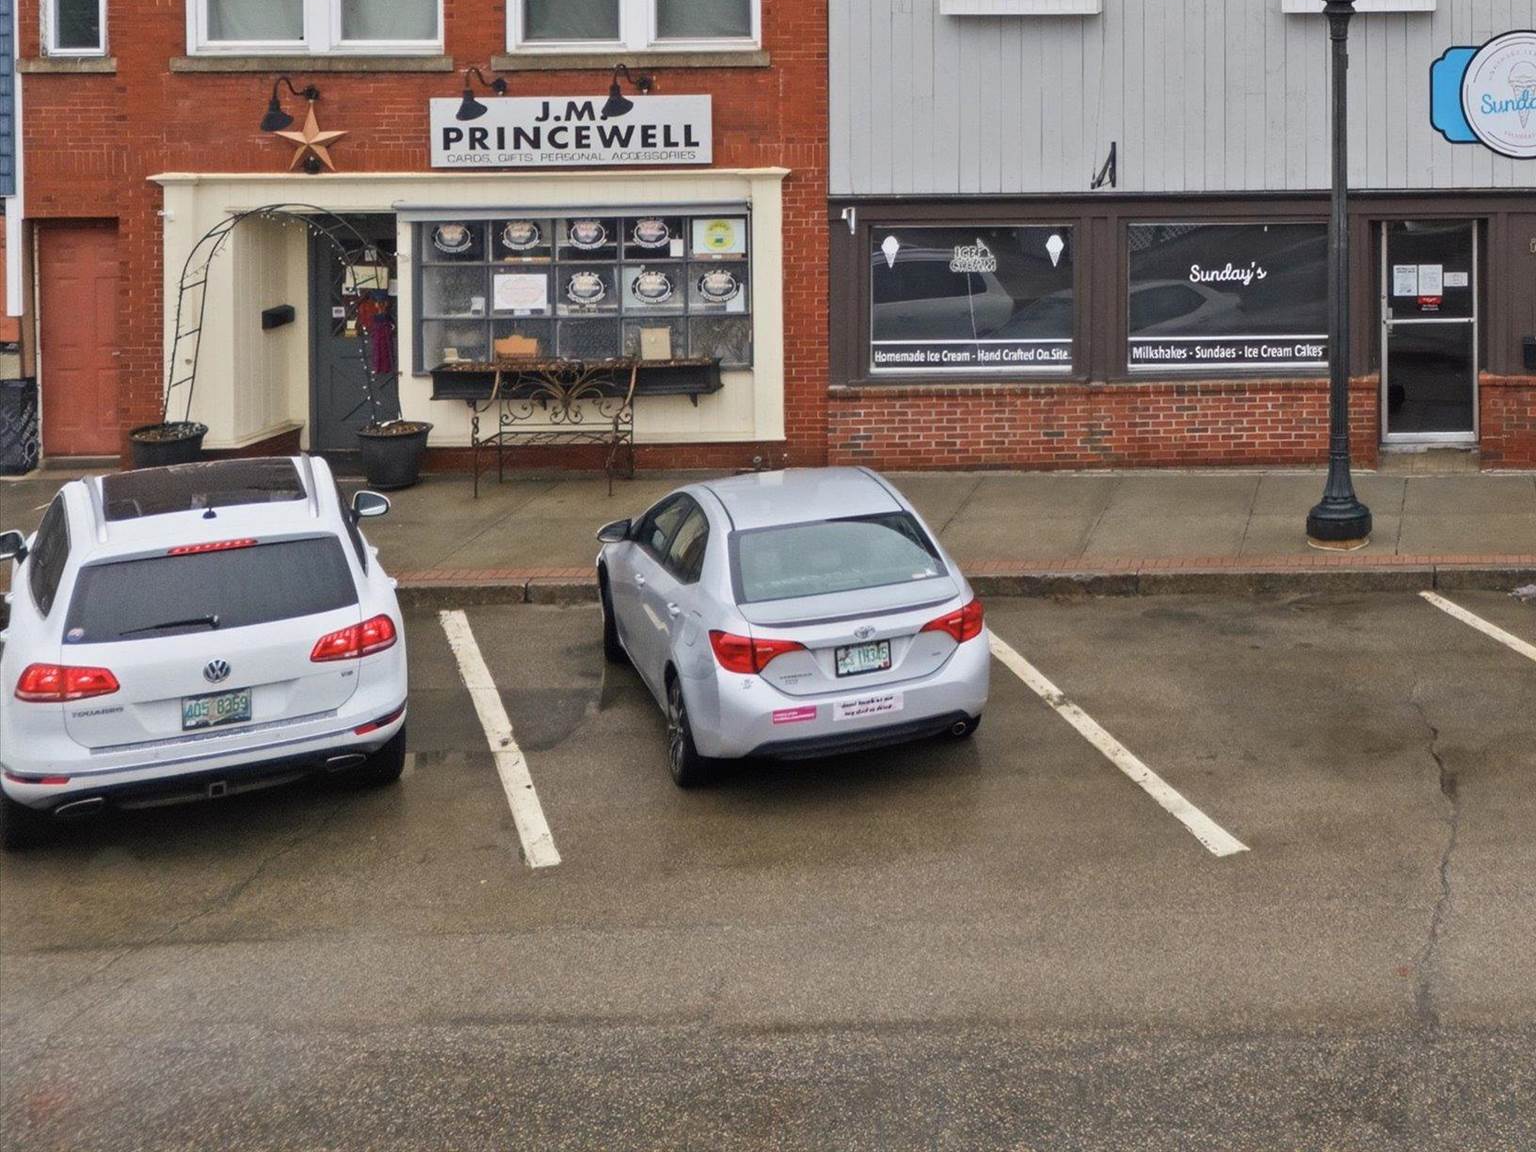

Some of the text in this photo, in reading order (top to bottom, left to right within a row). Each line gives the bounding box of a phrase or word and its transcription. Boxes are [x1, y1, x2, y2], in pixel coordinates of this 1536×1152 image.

[442, 124, 700, 151] PRINCEWELL
[540, 152, 604, 162] PERSONAL
[612, 151, 697, 161] ACCESSORIES
[1189, 261, 1268, 286] Sunday's
[874, 350, 926, 363] Homemade
[927, 350, 940, 362] Ice
[942, 350, 970, 362] Cream
[978, 349, 1001, 361] Hand
[1003, 348, 1034, 360] Crafted
[1037, 348, 1050, 359] On
[1051, 348, 1068, 359] Site
[1133, 346, 1187, 359] Milkshakes
[1195, 346, 1236, 359] Sundaes
[1245, 346, 1259, 358] Ice
[1260, 345, 1292, 358] Cream
[1295, 344, 1323, 357] Cakes
